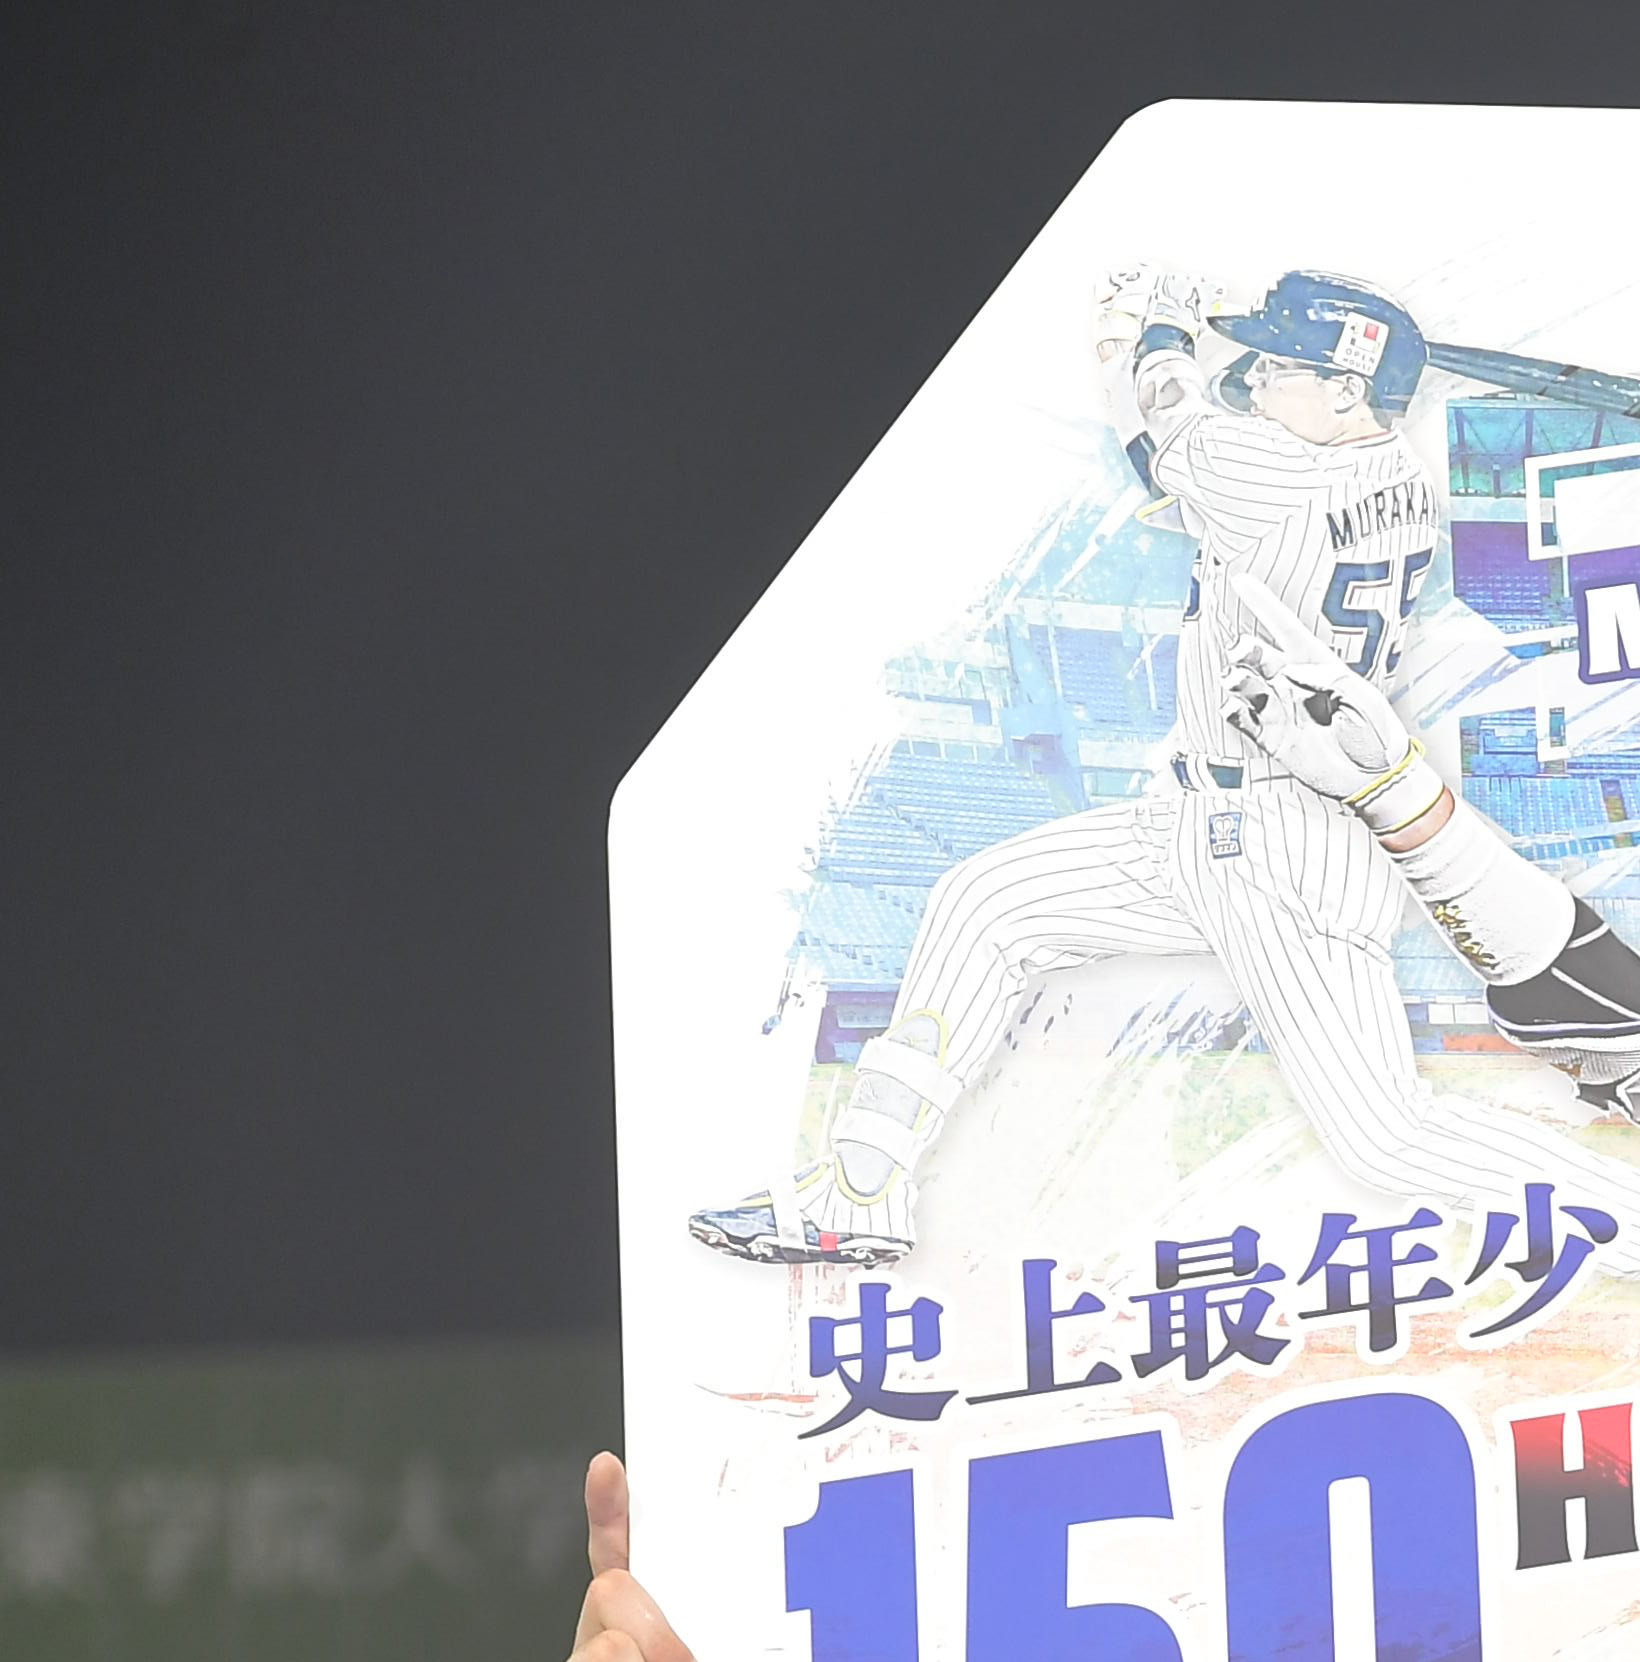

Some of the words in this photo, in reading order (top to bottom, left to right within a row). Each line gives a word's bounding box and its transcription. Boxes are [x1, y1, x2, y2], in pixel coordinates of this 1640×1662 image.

[1326, 481, 1438, 550] MURAKA
[797, 1183, 1619, 1440] 史上最年少
